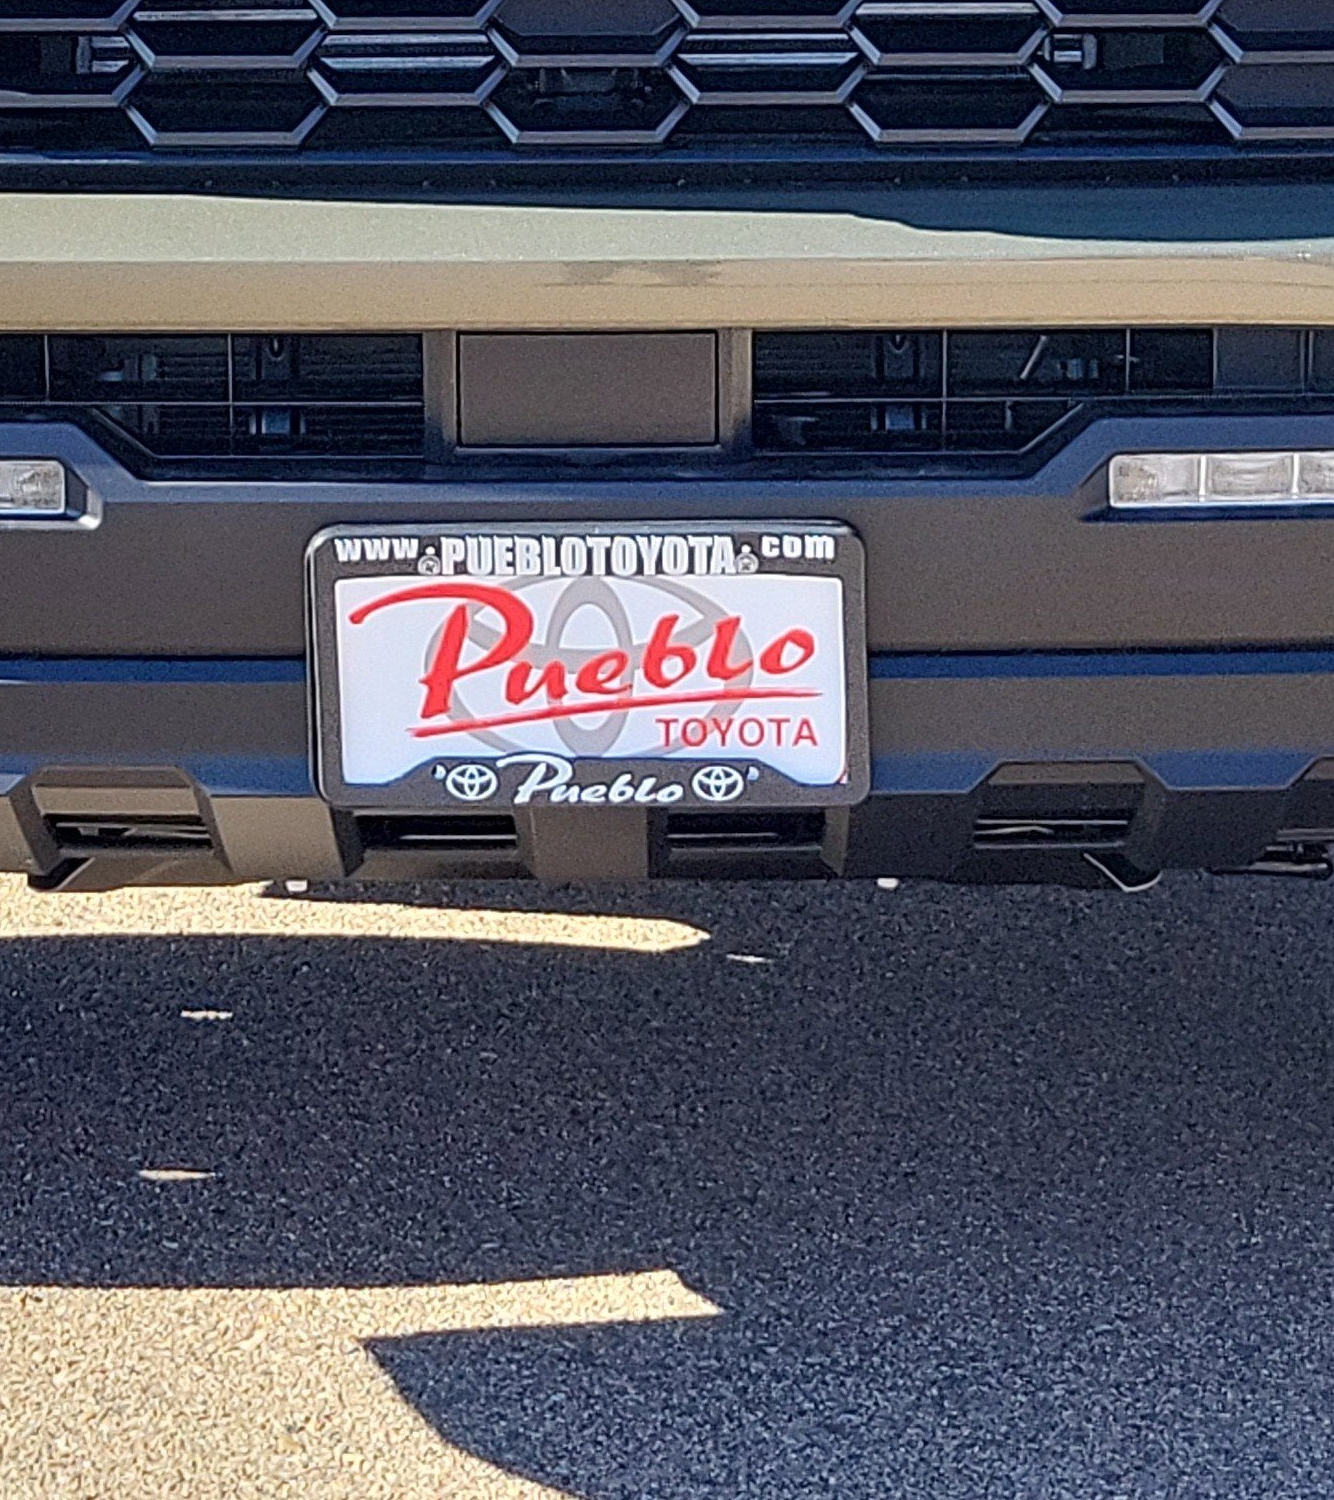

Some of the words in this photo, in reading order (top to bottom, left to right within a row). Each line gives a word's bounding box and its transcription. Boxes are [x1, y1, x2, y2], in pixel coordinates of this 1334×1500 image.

[349, 582, 817, 720] Pueblo
[655, 717, 819, 748] TOYOTA
[495, 753, 684, 805] Pueblo
